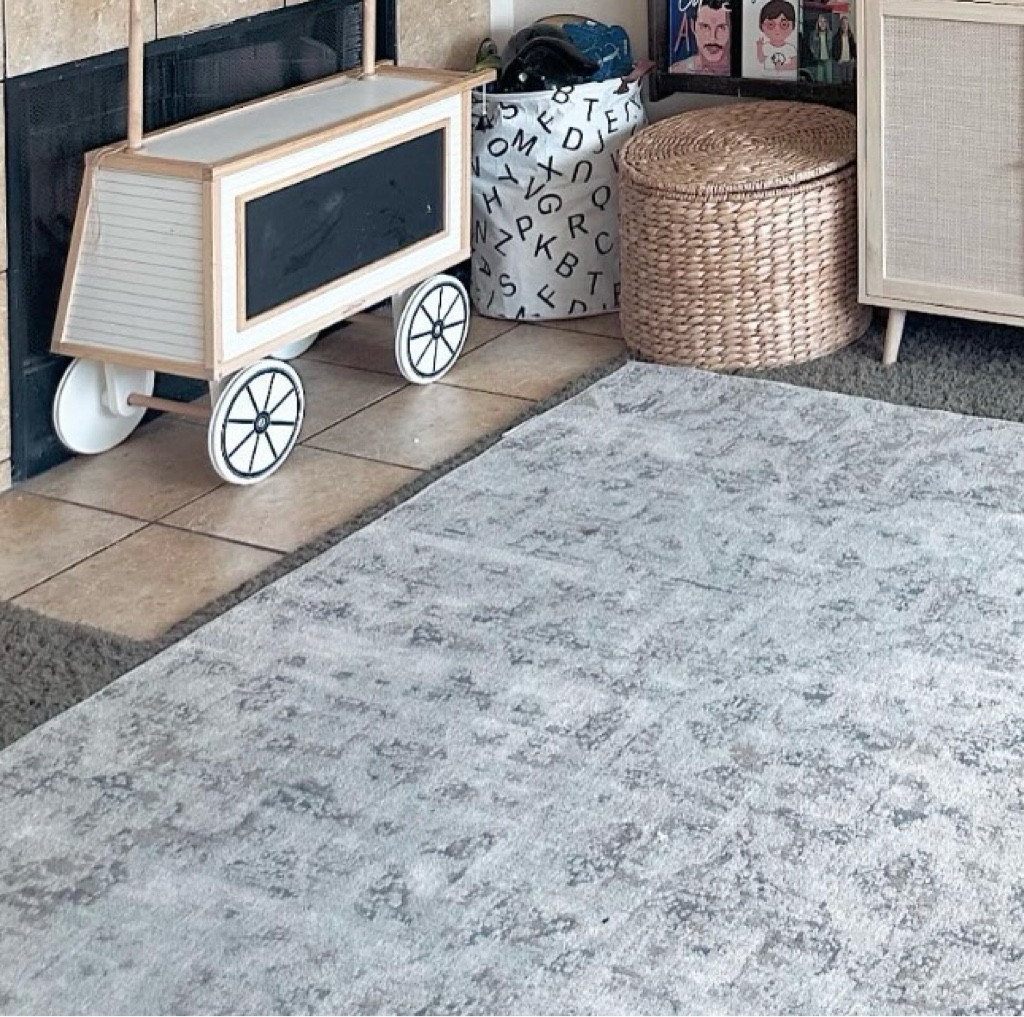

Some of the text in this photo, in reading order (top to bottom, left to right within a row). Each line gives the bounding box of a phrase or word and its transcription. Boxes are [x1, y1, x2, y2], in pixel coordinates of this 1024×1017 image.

[583, 98, 599, 122] T
[604, 109, 619, 134] E
[487, 137, 509, 158] O
[511, 128, 538, 157] M
[562, 127, 583, 152] D
[593, 129, 605, 154] J
[498, 164, 518, 185] Y
[537, 155, 563, 183] X
[482, 186, 503, 215] H
[537, 193, 562, 215] G
[591, 185, 611, 211] Q
[516, 215, 534, 242] P
[568, 213, 589, 239] R
[534, 233, 558, 260] K
[595, 231, 614, 255] C
[555, 251, 578, 279] B
[499, 273, 517, 298] S
[587, 271, 603, 295] T
